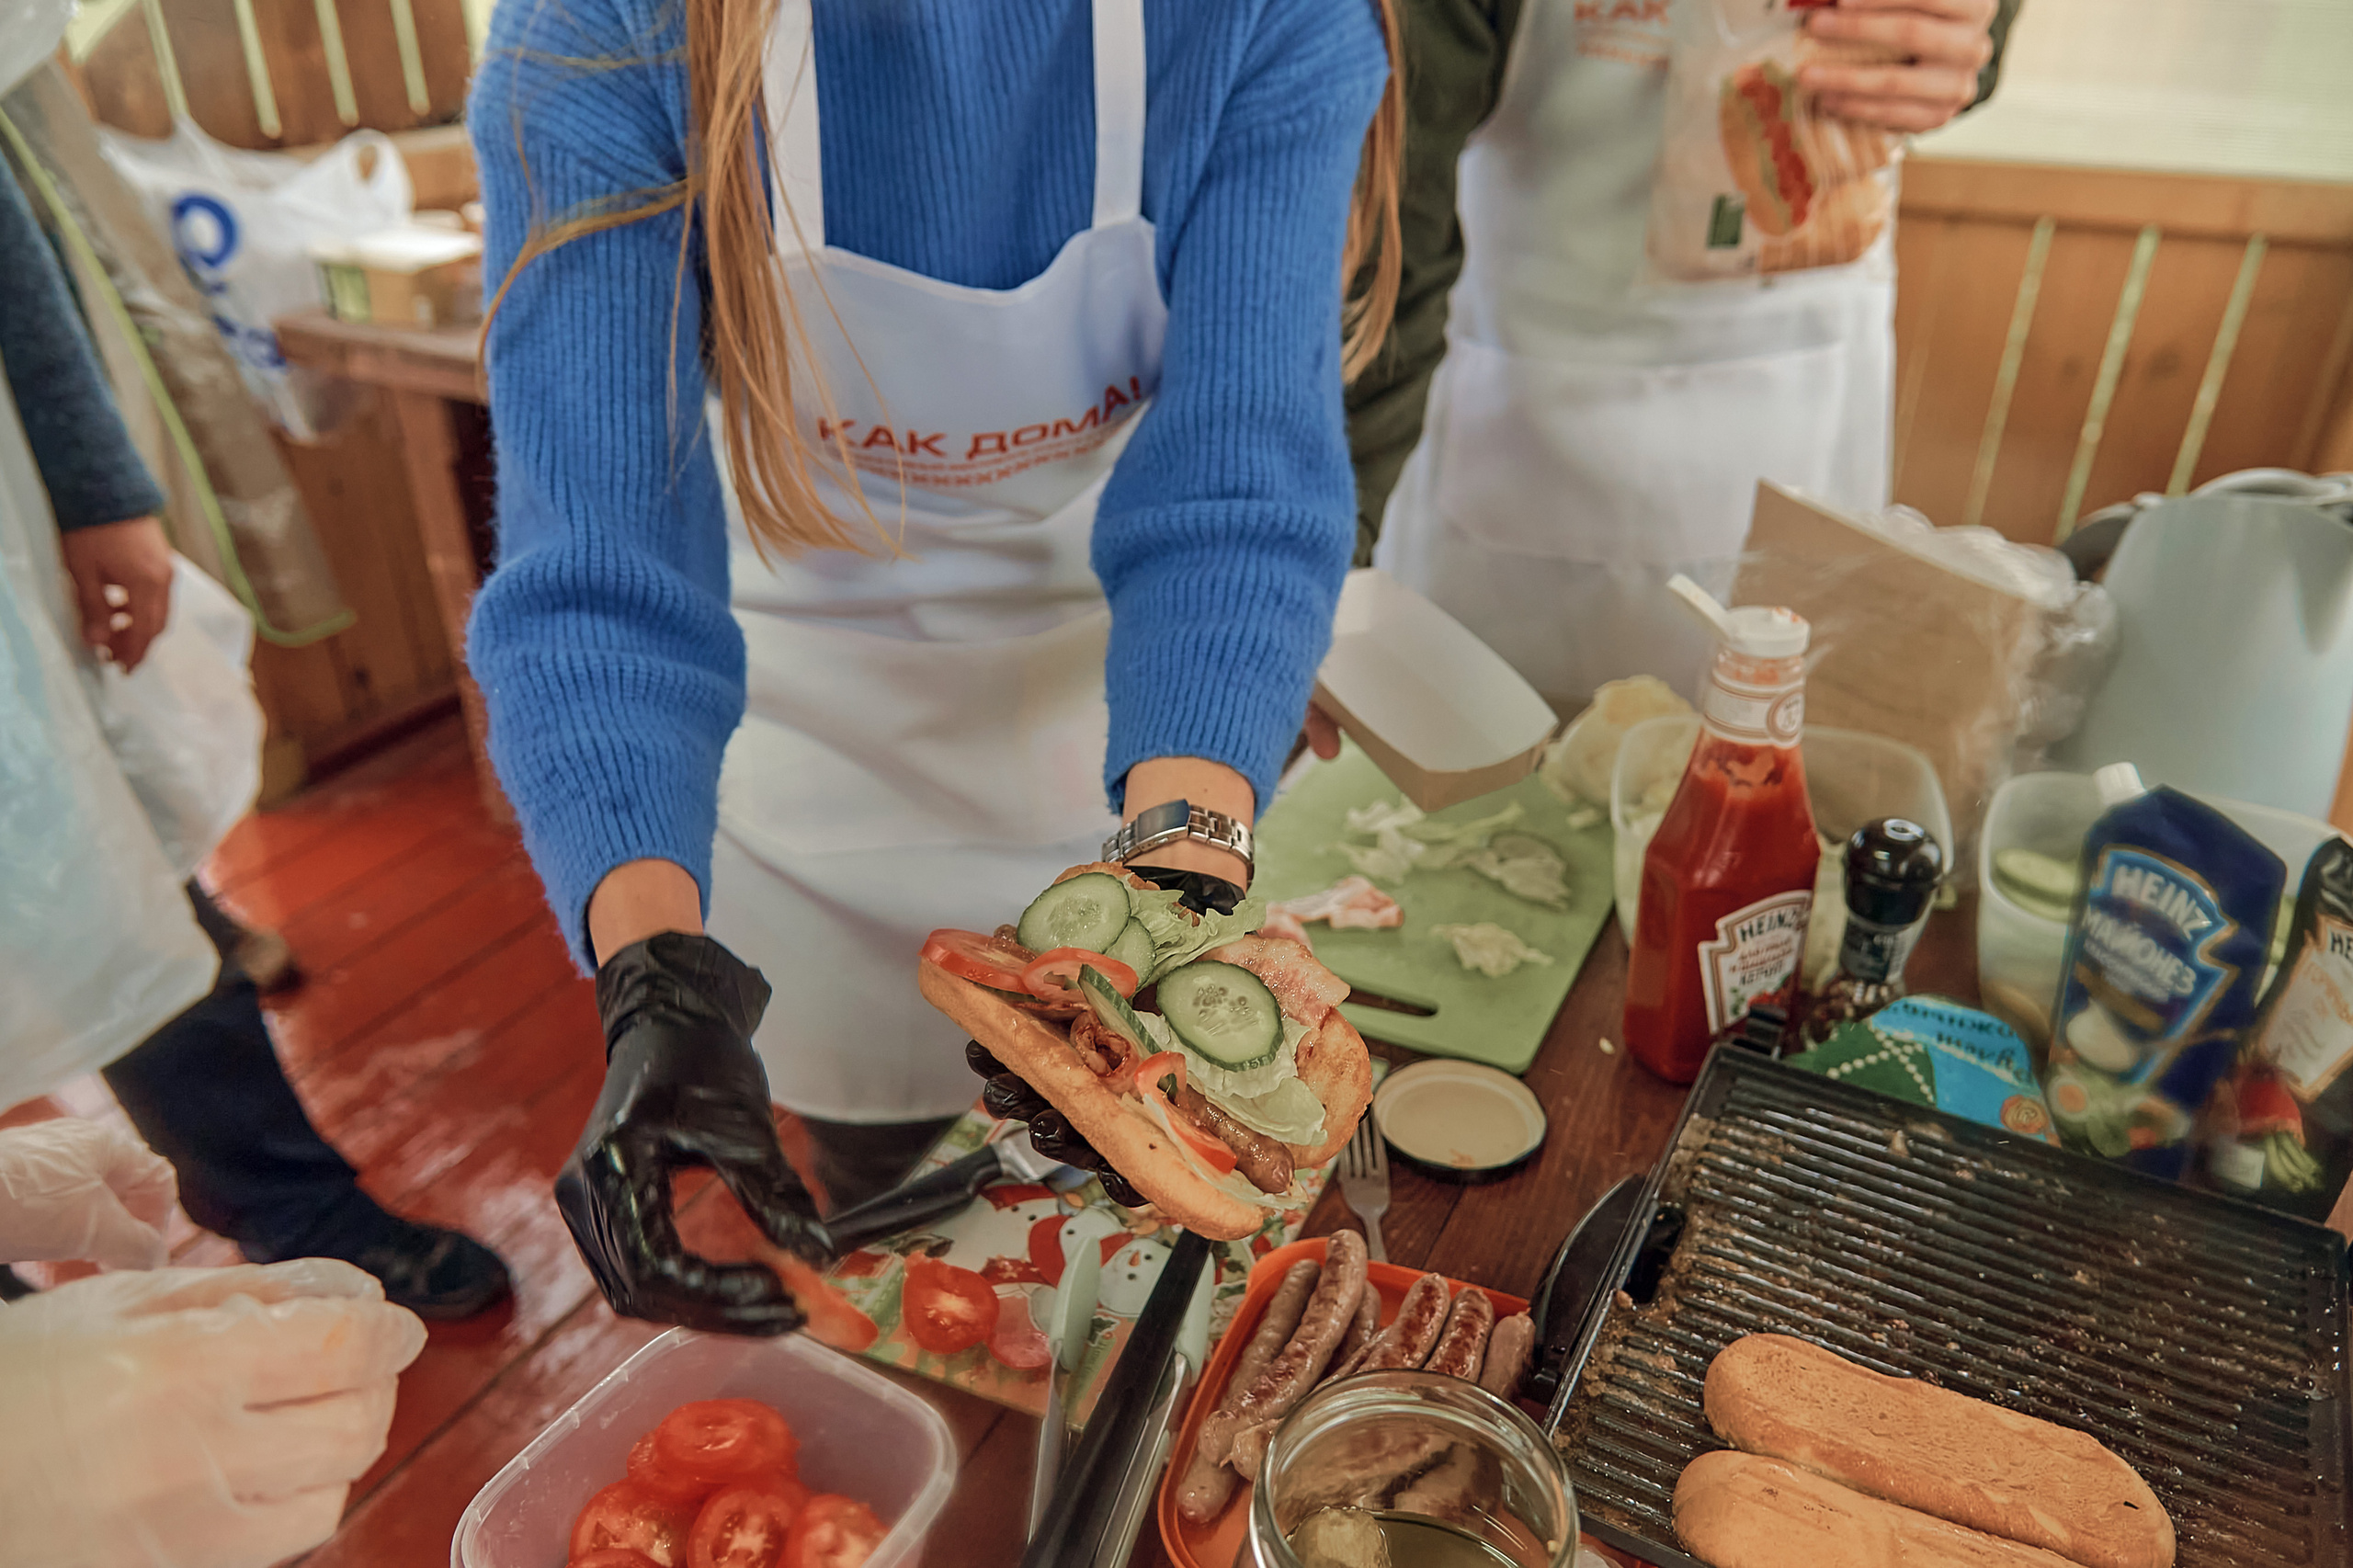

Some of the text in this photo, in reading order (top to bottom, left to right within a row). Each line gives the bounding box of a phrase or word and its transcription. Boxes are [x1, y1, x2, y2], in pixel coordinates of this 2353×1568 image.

[817, 375, 1142, 460] КАК ДОМА!
[2110, 864, 2212, 941] HEINZ
